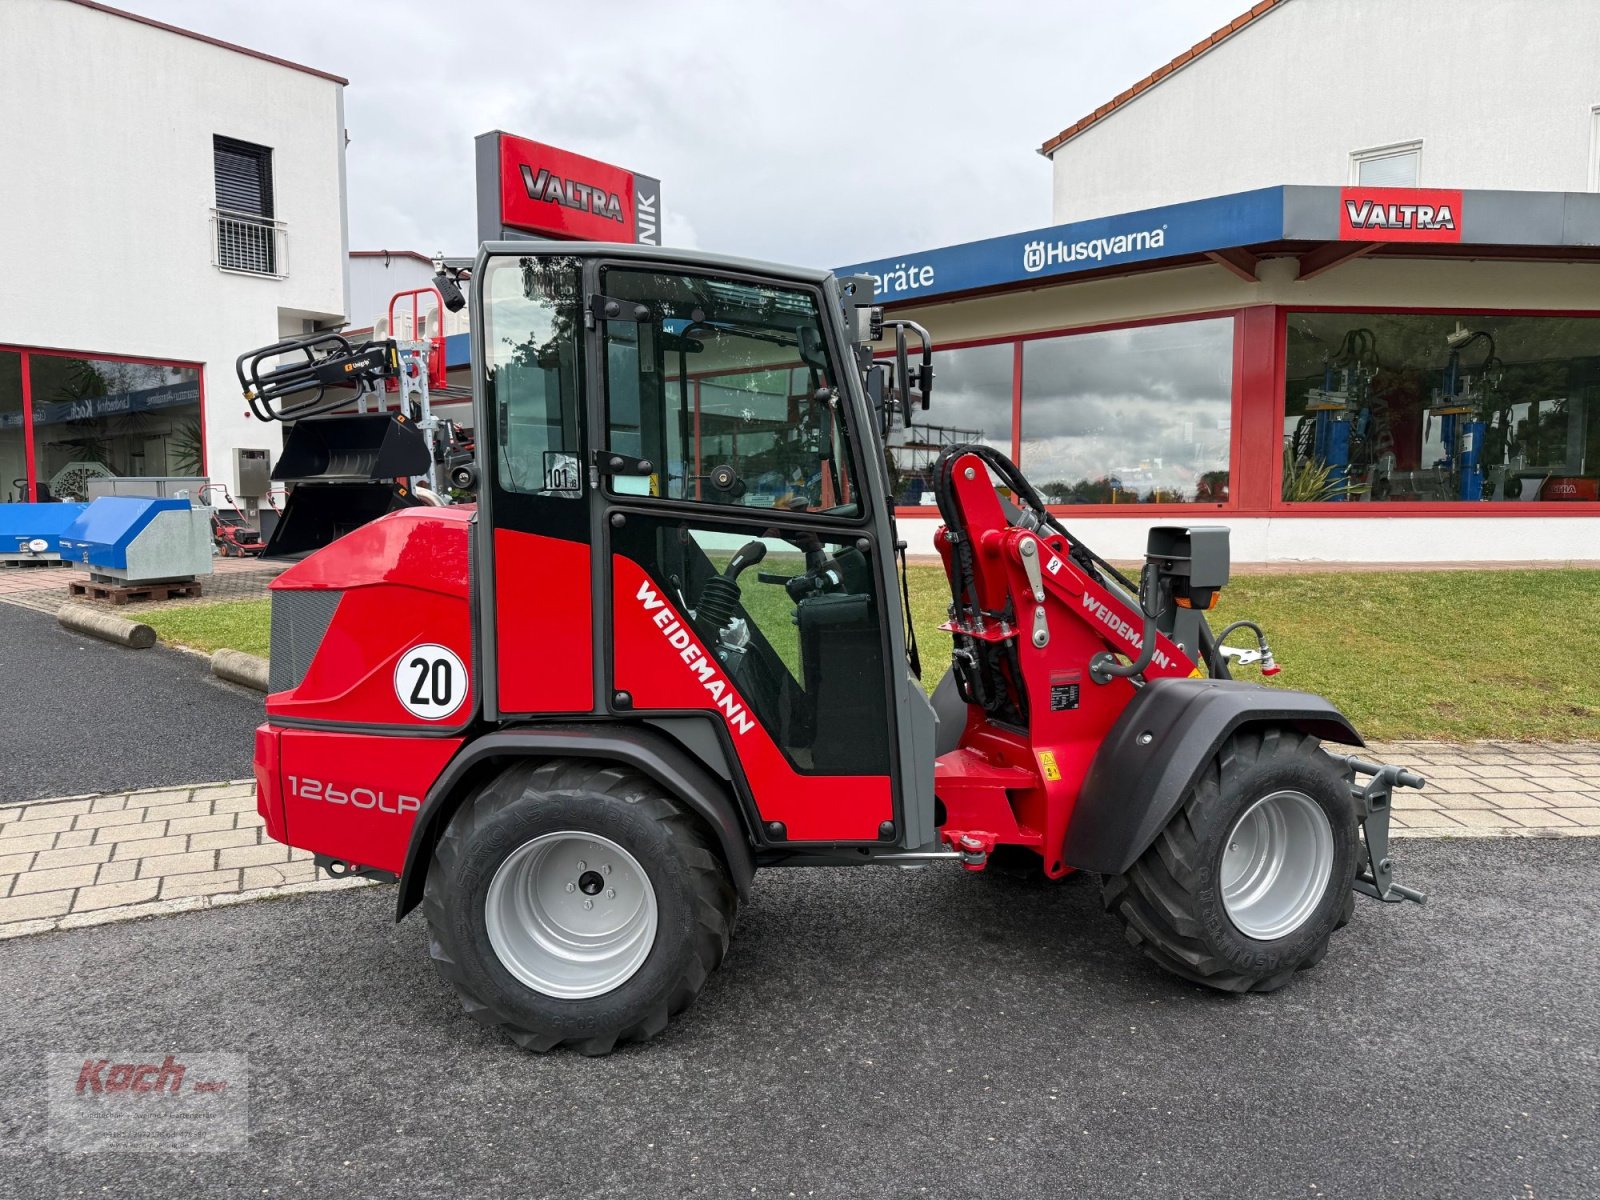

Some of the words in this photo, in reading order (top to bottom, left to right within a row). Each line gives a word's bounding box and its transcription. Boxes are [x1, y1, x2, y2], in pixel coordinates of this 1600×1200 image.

[519, 164, 624, 223] VALTRA
[1345, 200, 1456, 230] VALTRA
[1047, 226, 1166, 265] Husqvarna
[547, 469, 568, 488] 101
[636, 580, 755, 735] WEIDEMANN
[410, 657, 452, 706] 20
[288, 775, 421, 814] 1260LP
